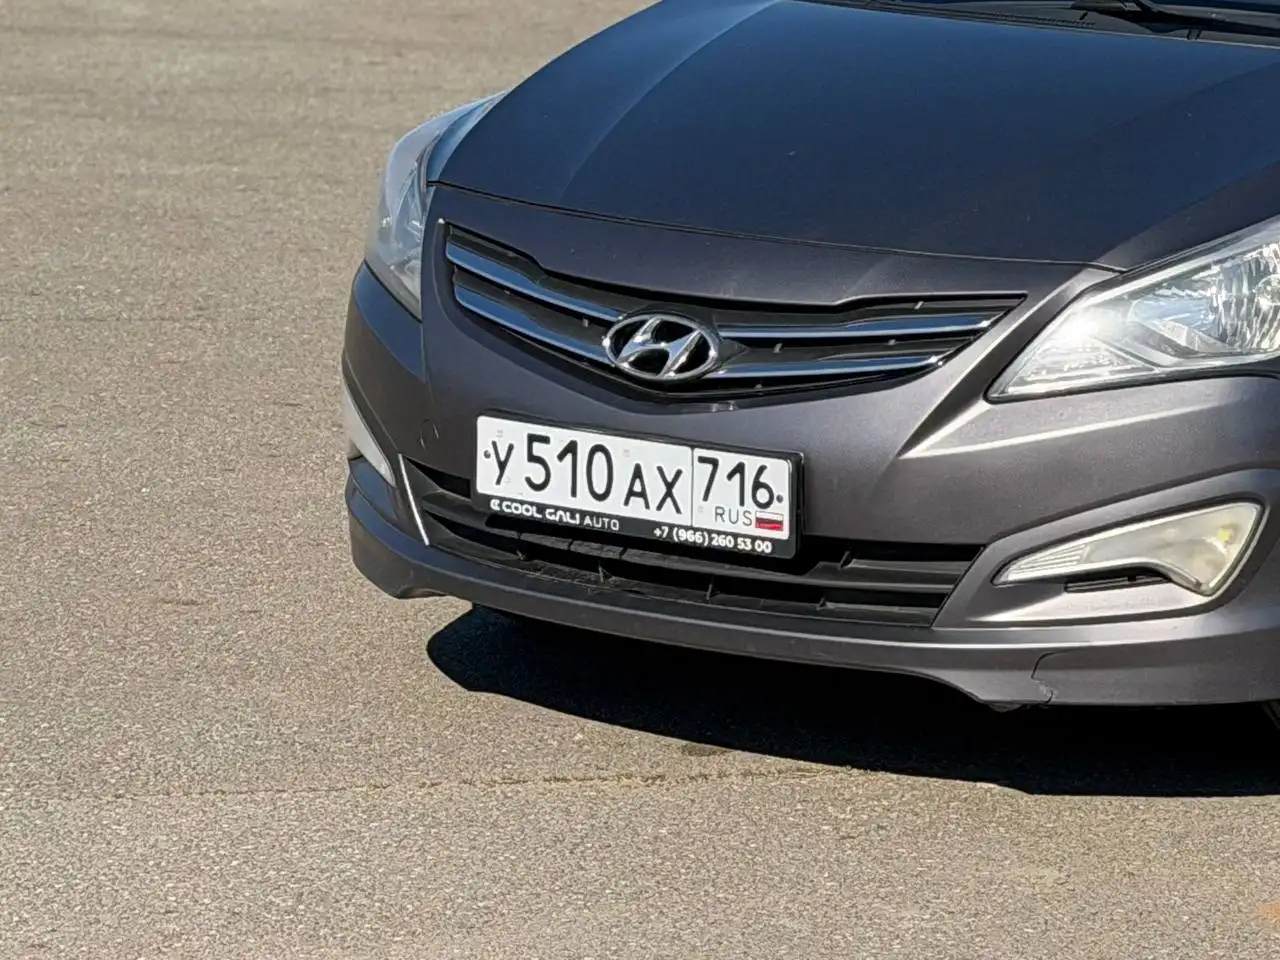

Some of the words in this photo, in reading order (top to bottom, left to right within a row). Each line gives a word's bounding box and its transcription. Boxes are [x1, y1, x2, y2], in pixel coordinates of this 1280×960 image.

[697, 455, 776, 510] 716
[502, 501, 543, 518] COOL
[583, 515, 620, 531] AUTO
[714, 506, 753, 527] RUS
[653, 526, 669, 539] +7
[672, 526, 709, 547] (966)
[711, 533, 735, 549] 260
[737, 536, 753, 552] 53
[754, 540, 773, 554] 00
